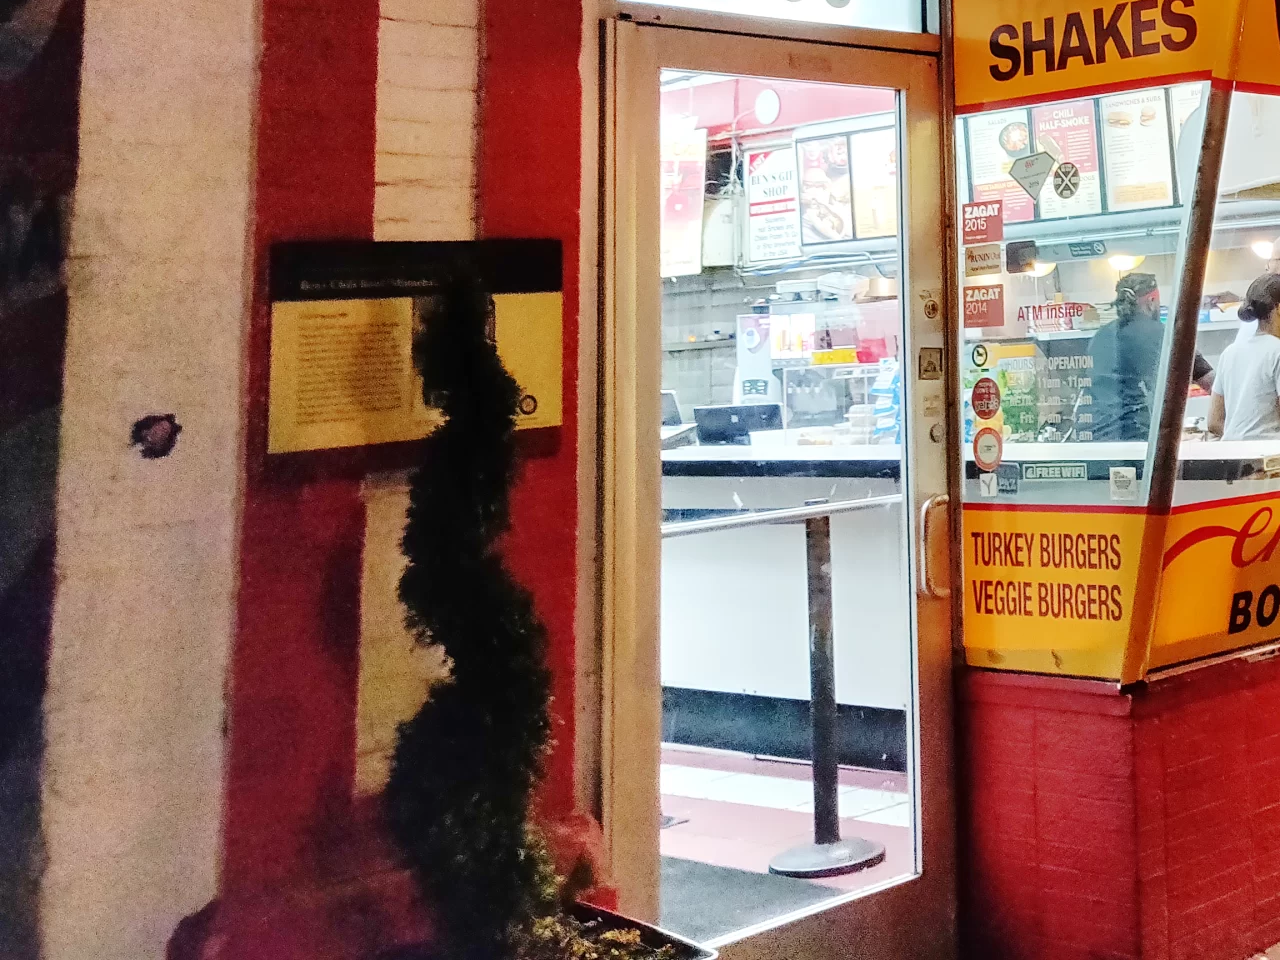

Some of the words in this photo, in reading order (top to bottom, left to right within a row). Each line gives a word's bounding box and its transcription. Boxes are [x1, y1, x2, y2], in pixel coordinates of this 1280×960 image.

[1053, 107, 1074, 120] CHILI
[1039, 116, 1090, 132] HALF-SMOKE
[964, 203, 1000, 219] ZAGAT
[965, 218, 987, 232] 2015
[965, 287, 1001, 301] ZAGAT
[966, 301, 988, 315] 2014
[1017, 304, 1043, 322] ATM
[1047, 303, 1083, 319] inside
[1047, 355, 1095, 370] OPERATION
[1036, 467, 1061, 478] FREE
[1062, 466, 1085, 478] WIFI
[971, 531, 1037, 569] TURKEY
[1039, 532, 1121, 571] BURGERS
[972, 579, 1034, 617] VEGGIE
[1038, 583, 1123, 622] BURGERS
